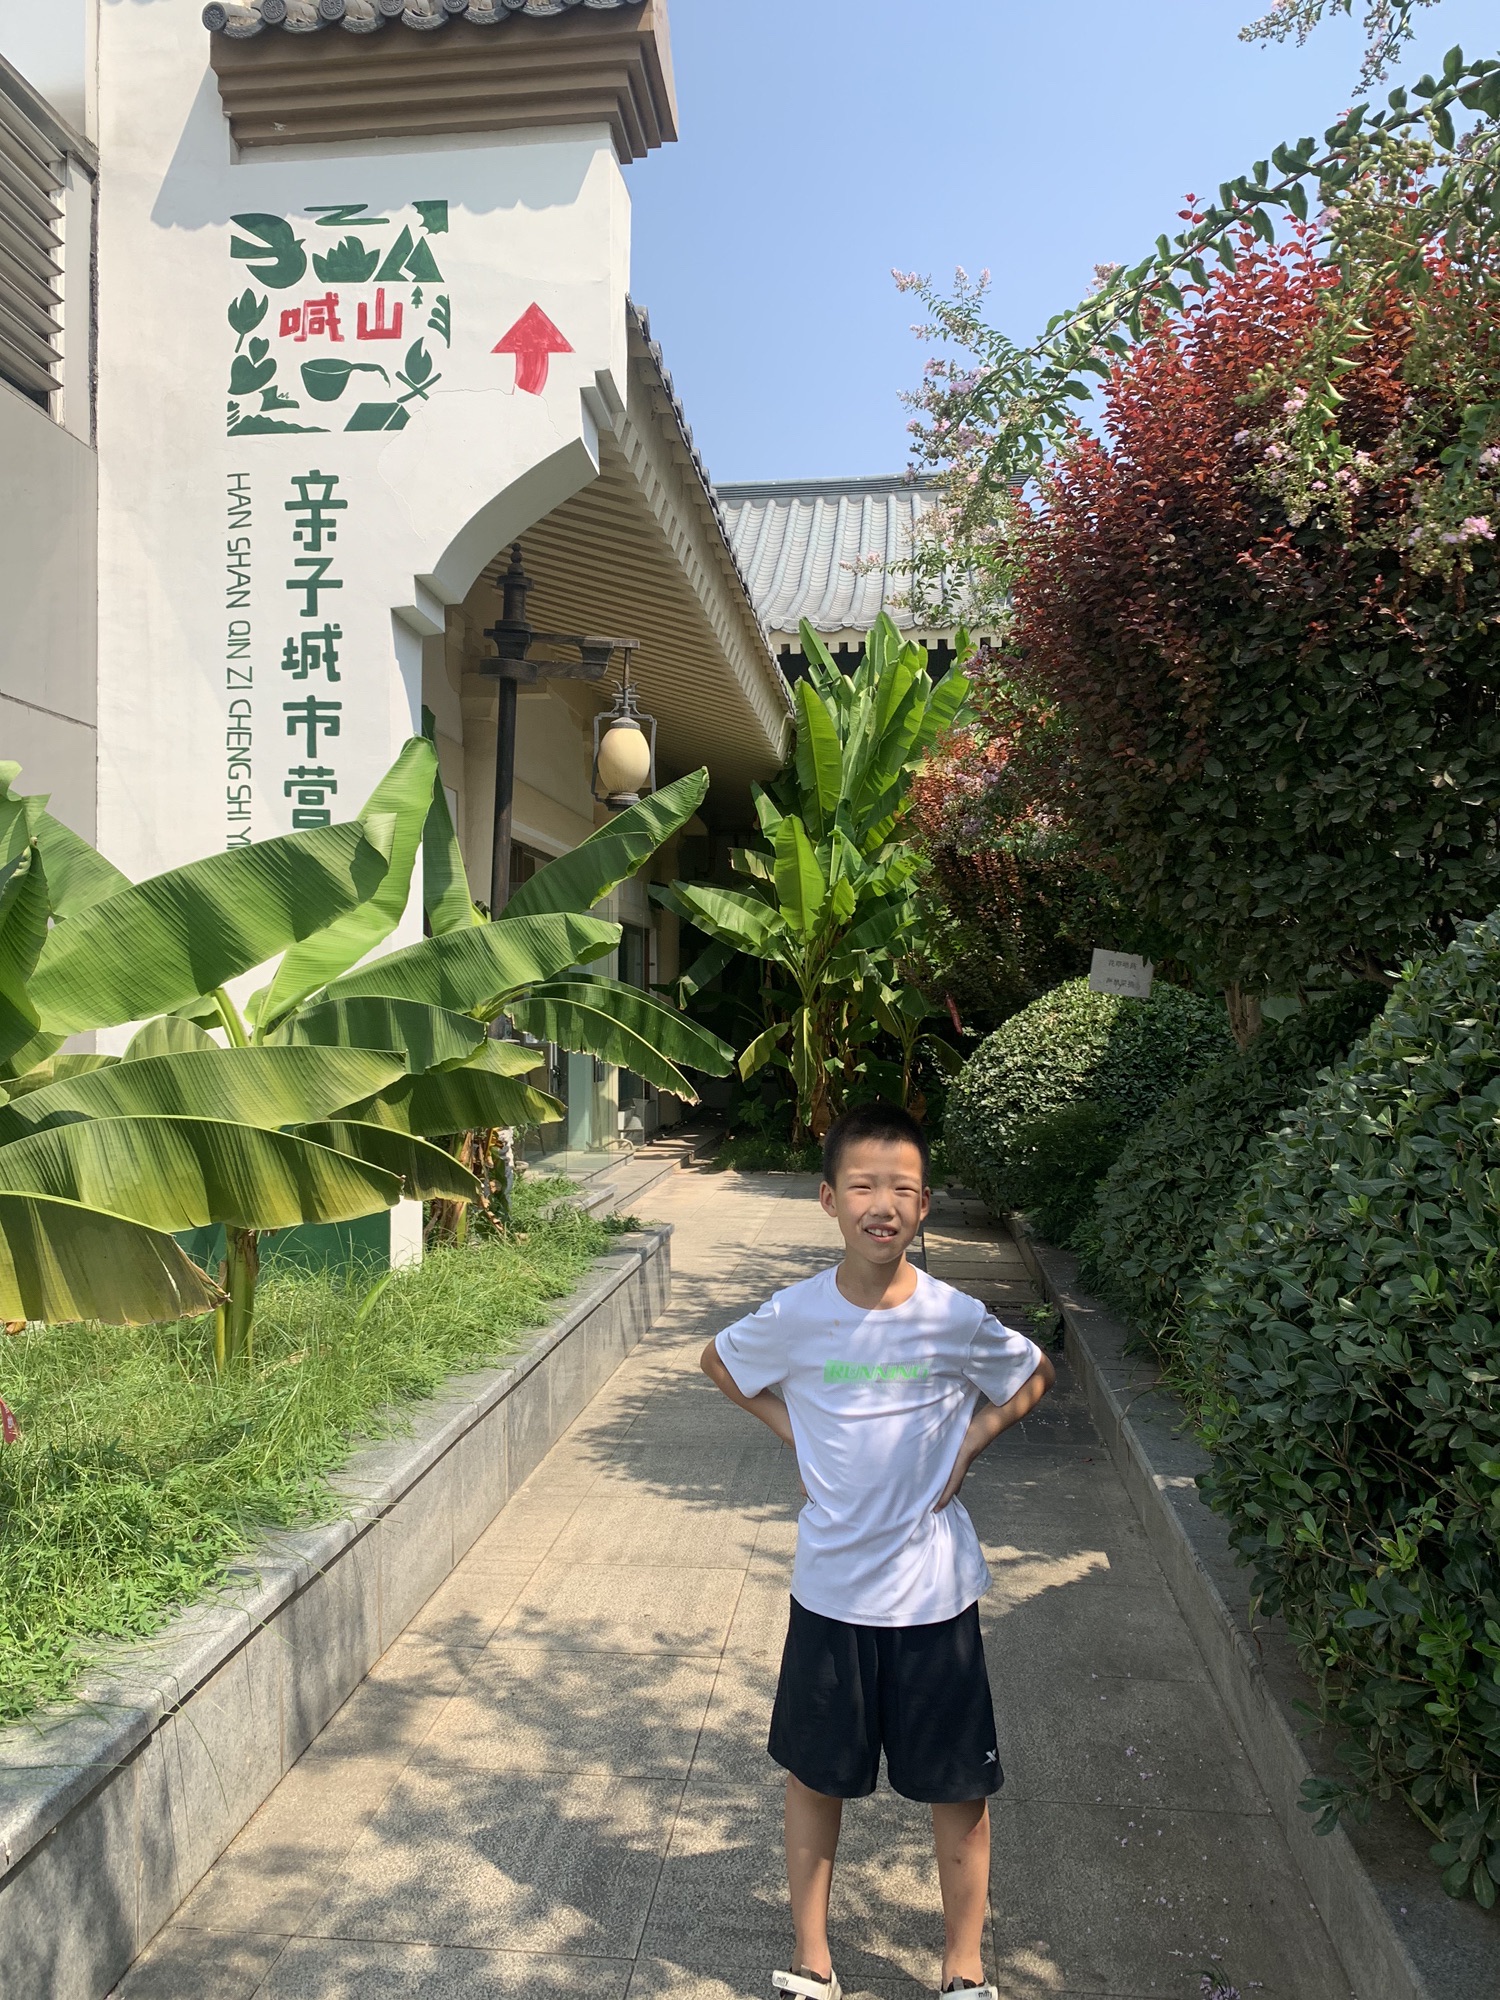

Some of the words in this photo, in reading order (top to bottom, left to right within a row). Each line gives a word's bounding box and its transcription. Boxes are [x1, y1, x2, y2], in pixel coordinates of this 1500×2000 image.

[279, 288, 403, 342] 喊山
[226, 473, 252, 529] HAN
[226, 537, 252, 608] SHAN
[226, 620, 252, 659] QIN
[281, 469, 348, 829] 亲子城市营
[226, 666, 253, 690] ZI
[226, 826, 252, 850] YI
